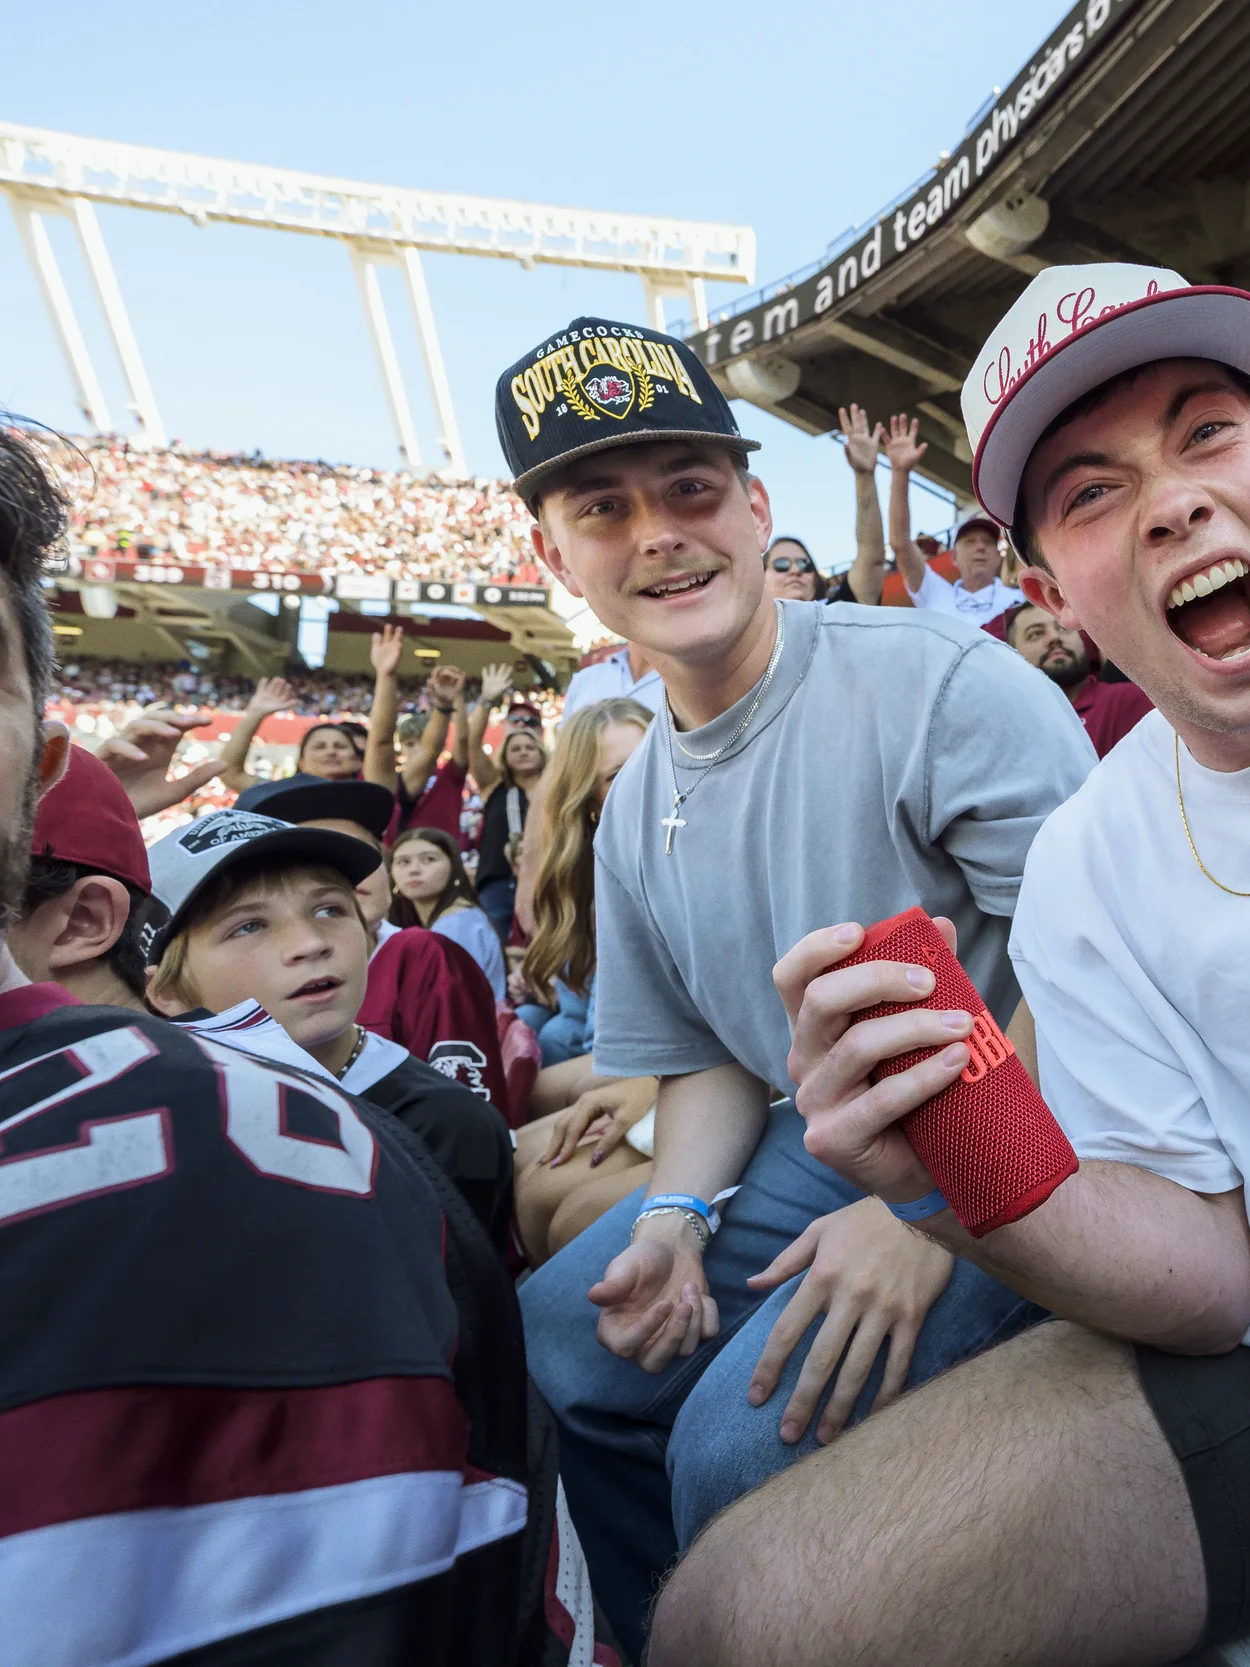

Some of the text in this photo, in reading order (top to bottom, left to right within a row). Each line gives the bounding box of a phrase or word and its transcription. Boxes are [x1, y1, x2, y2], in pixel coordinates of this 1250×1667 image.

[690, 21, 1085, 366] tem and team physicians
[536, 325, 644, 360] GAMECOCKS
[511, 336, 703, 441] SOUTH CAROLINA
[655, 383, 669, 394] 01
[556, 405, 568, 416] 18
[252, 572, 301, 590] 310
[210, 834, 227, 846] OF
[961, 1009, 1017, 1083] JBL
